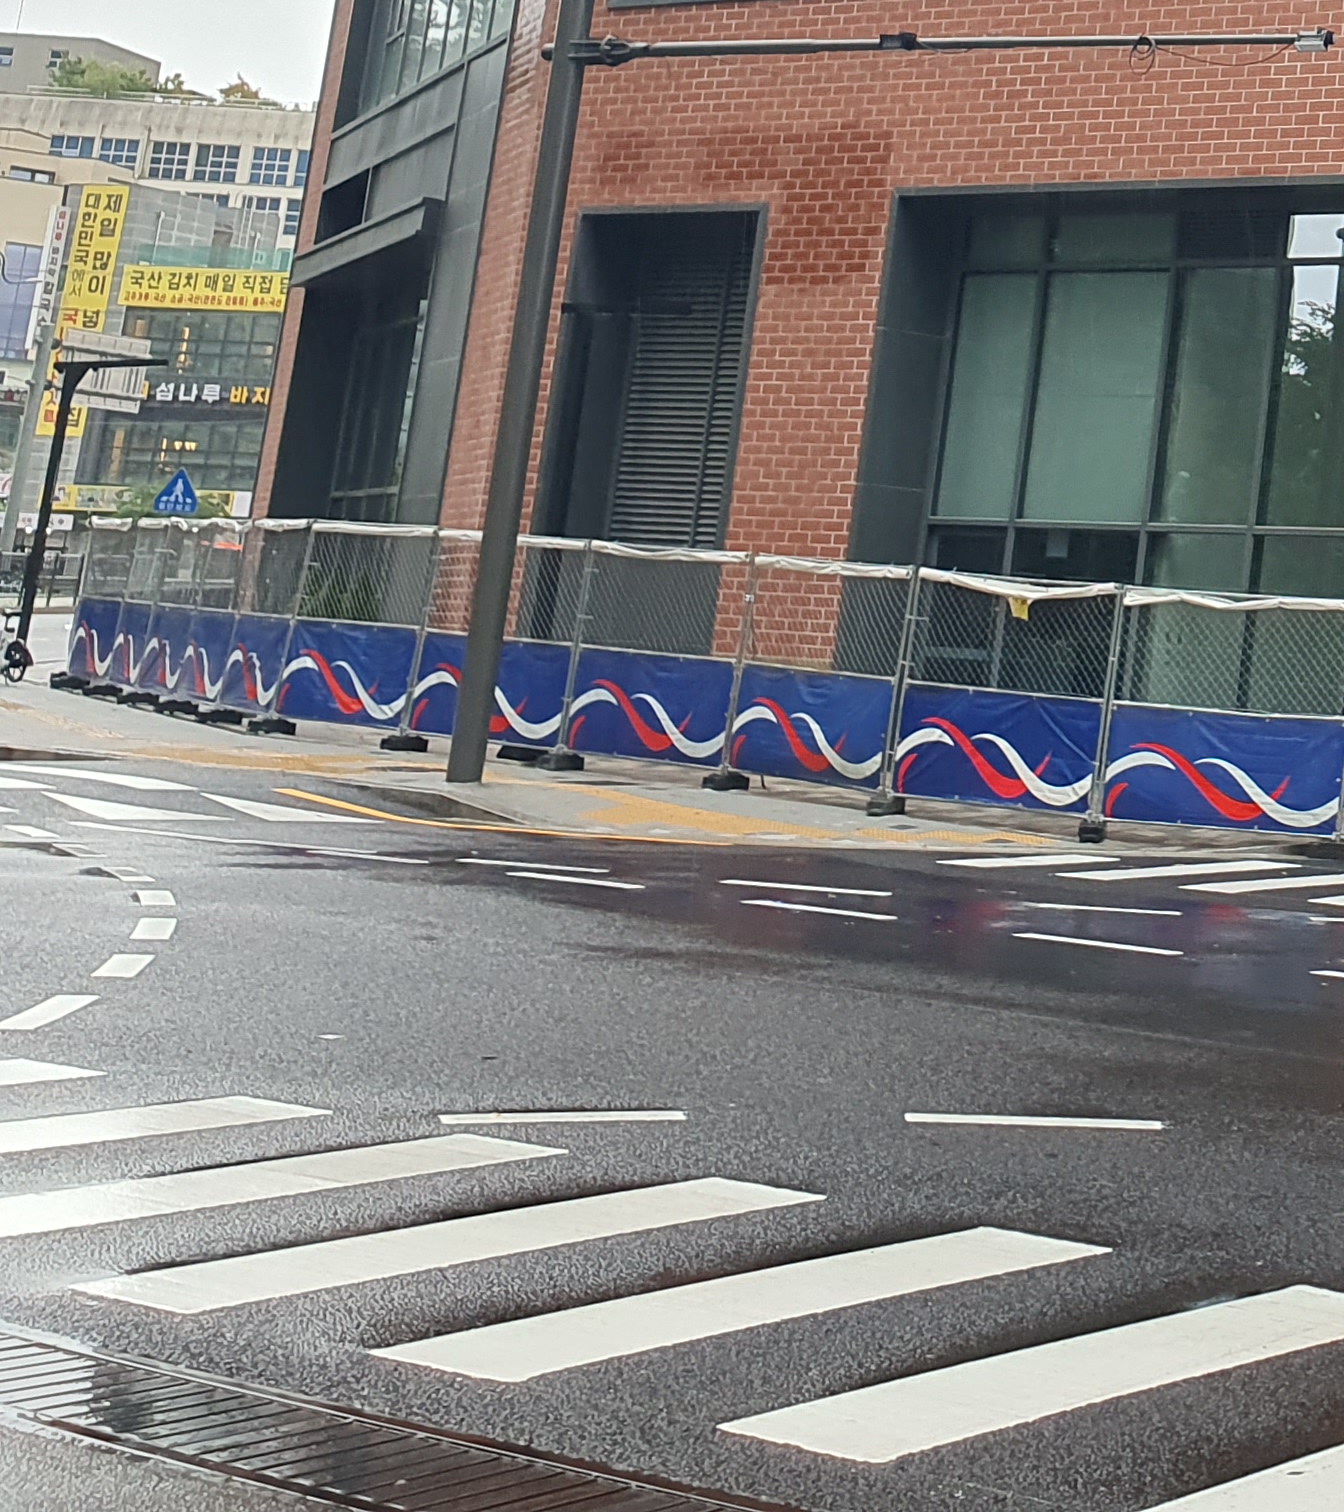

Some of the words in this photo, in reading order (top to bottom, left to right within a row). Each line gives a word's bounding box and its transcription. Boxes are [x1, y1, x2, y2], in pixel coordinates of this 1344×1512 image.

[99, 194, 123, 237] 제일
[88, 251, 111, 295] 많이
[130, 270, 162, 290] 국산
[168, 272, 199, 291] 김치
[204, 274, 237, 293] 매일
[242, 275, 273, 294] 직접
[156, 382, 221, 404] 섬나루
